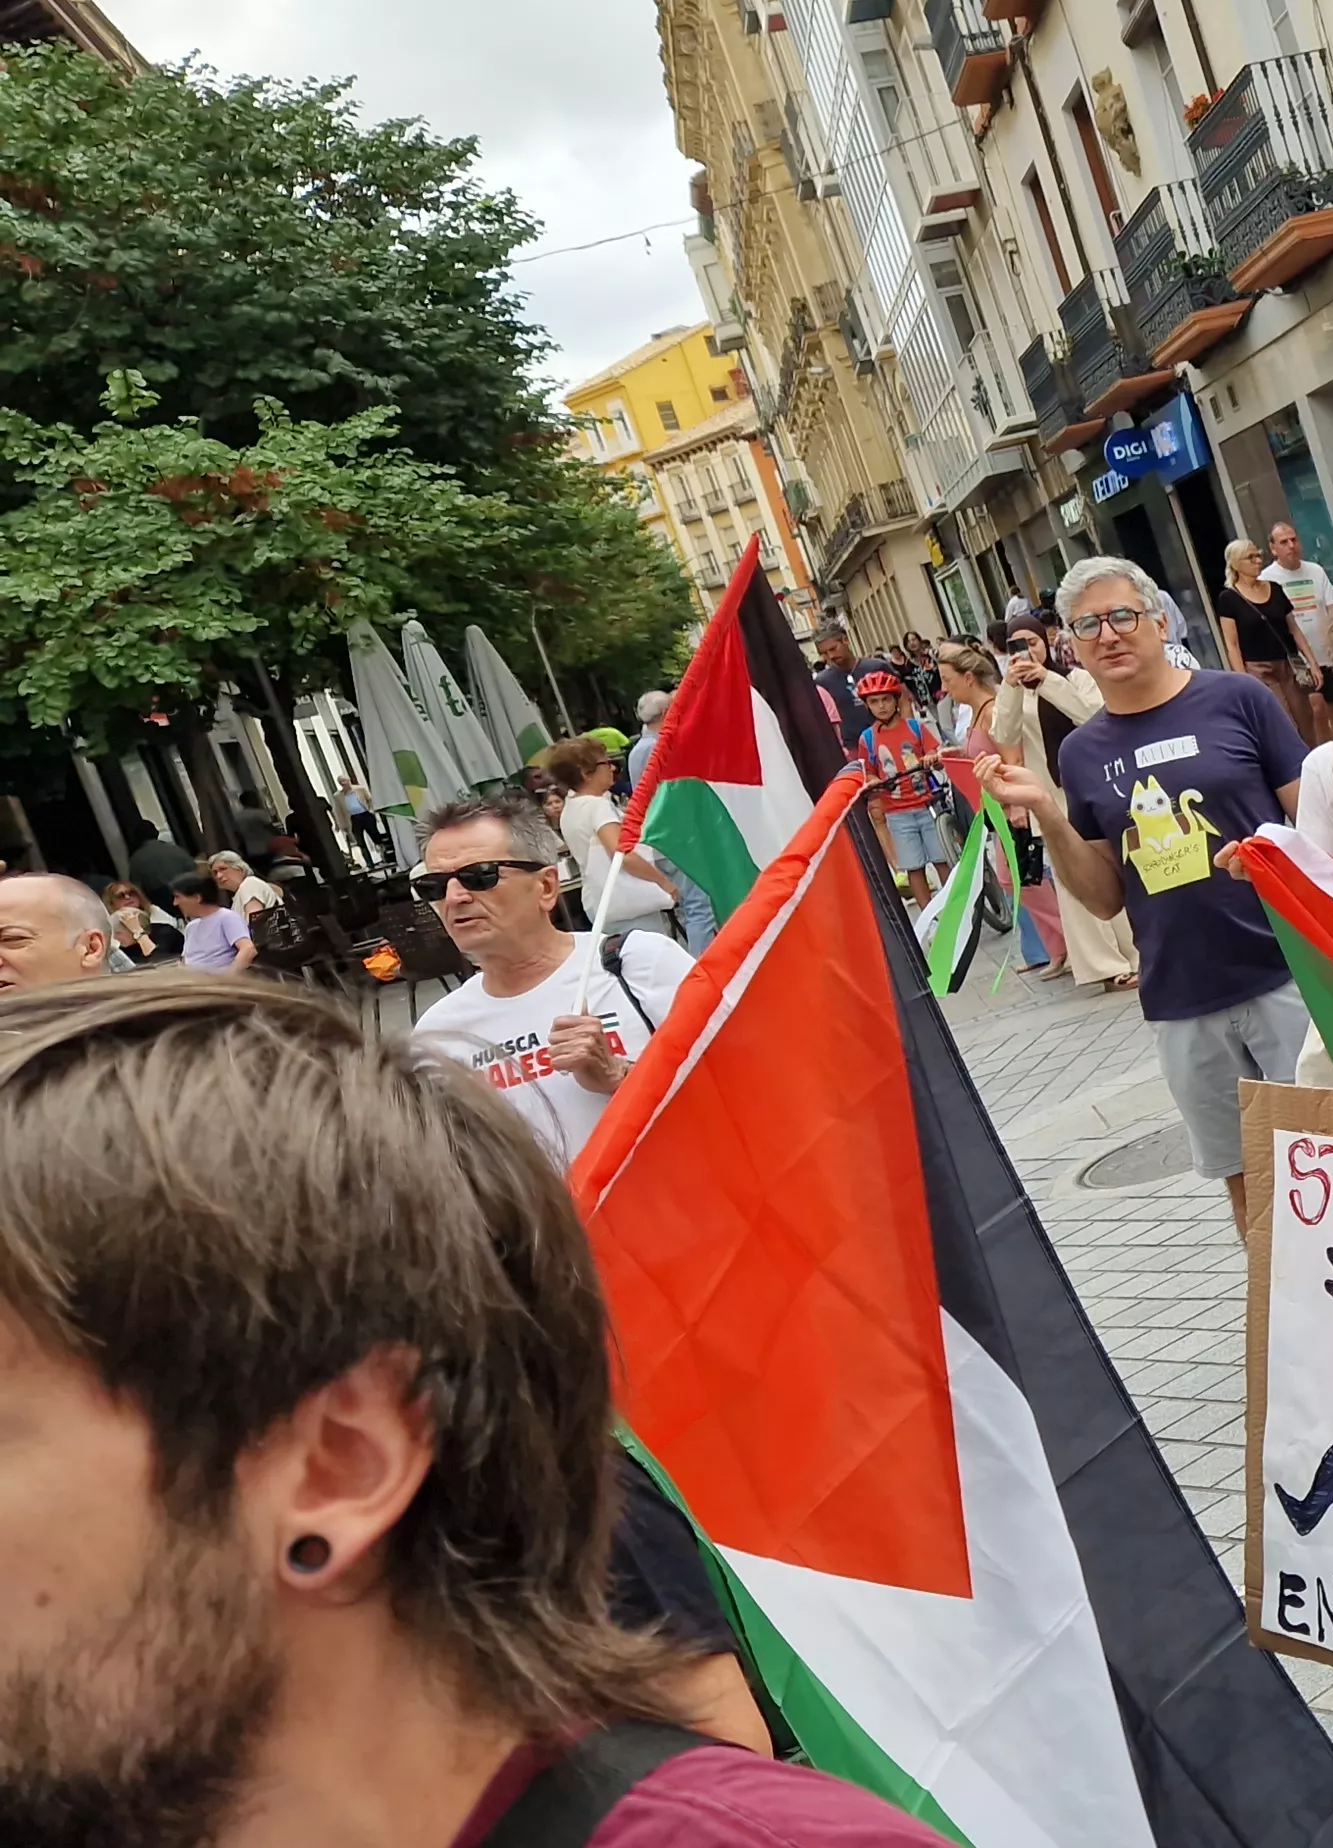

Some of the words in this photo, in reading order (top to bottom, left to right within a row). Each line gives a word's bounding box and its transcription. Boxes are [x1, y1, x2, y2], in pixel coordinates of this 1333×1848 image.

[1112, 440, 1148, 460] DIGI
[1103, 757, 1126, 783] I'M
[1163, 862, 1181, 877] CAT
[472, 1032, 541, 1068] HUESCA
